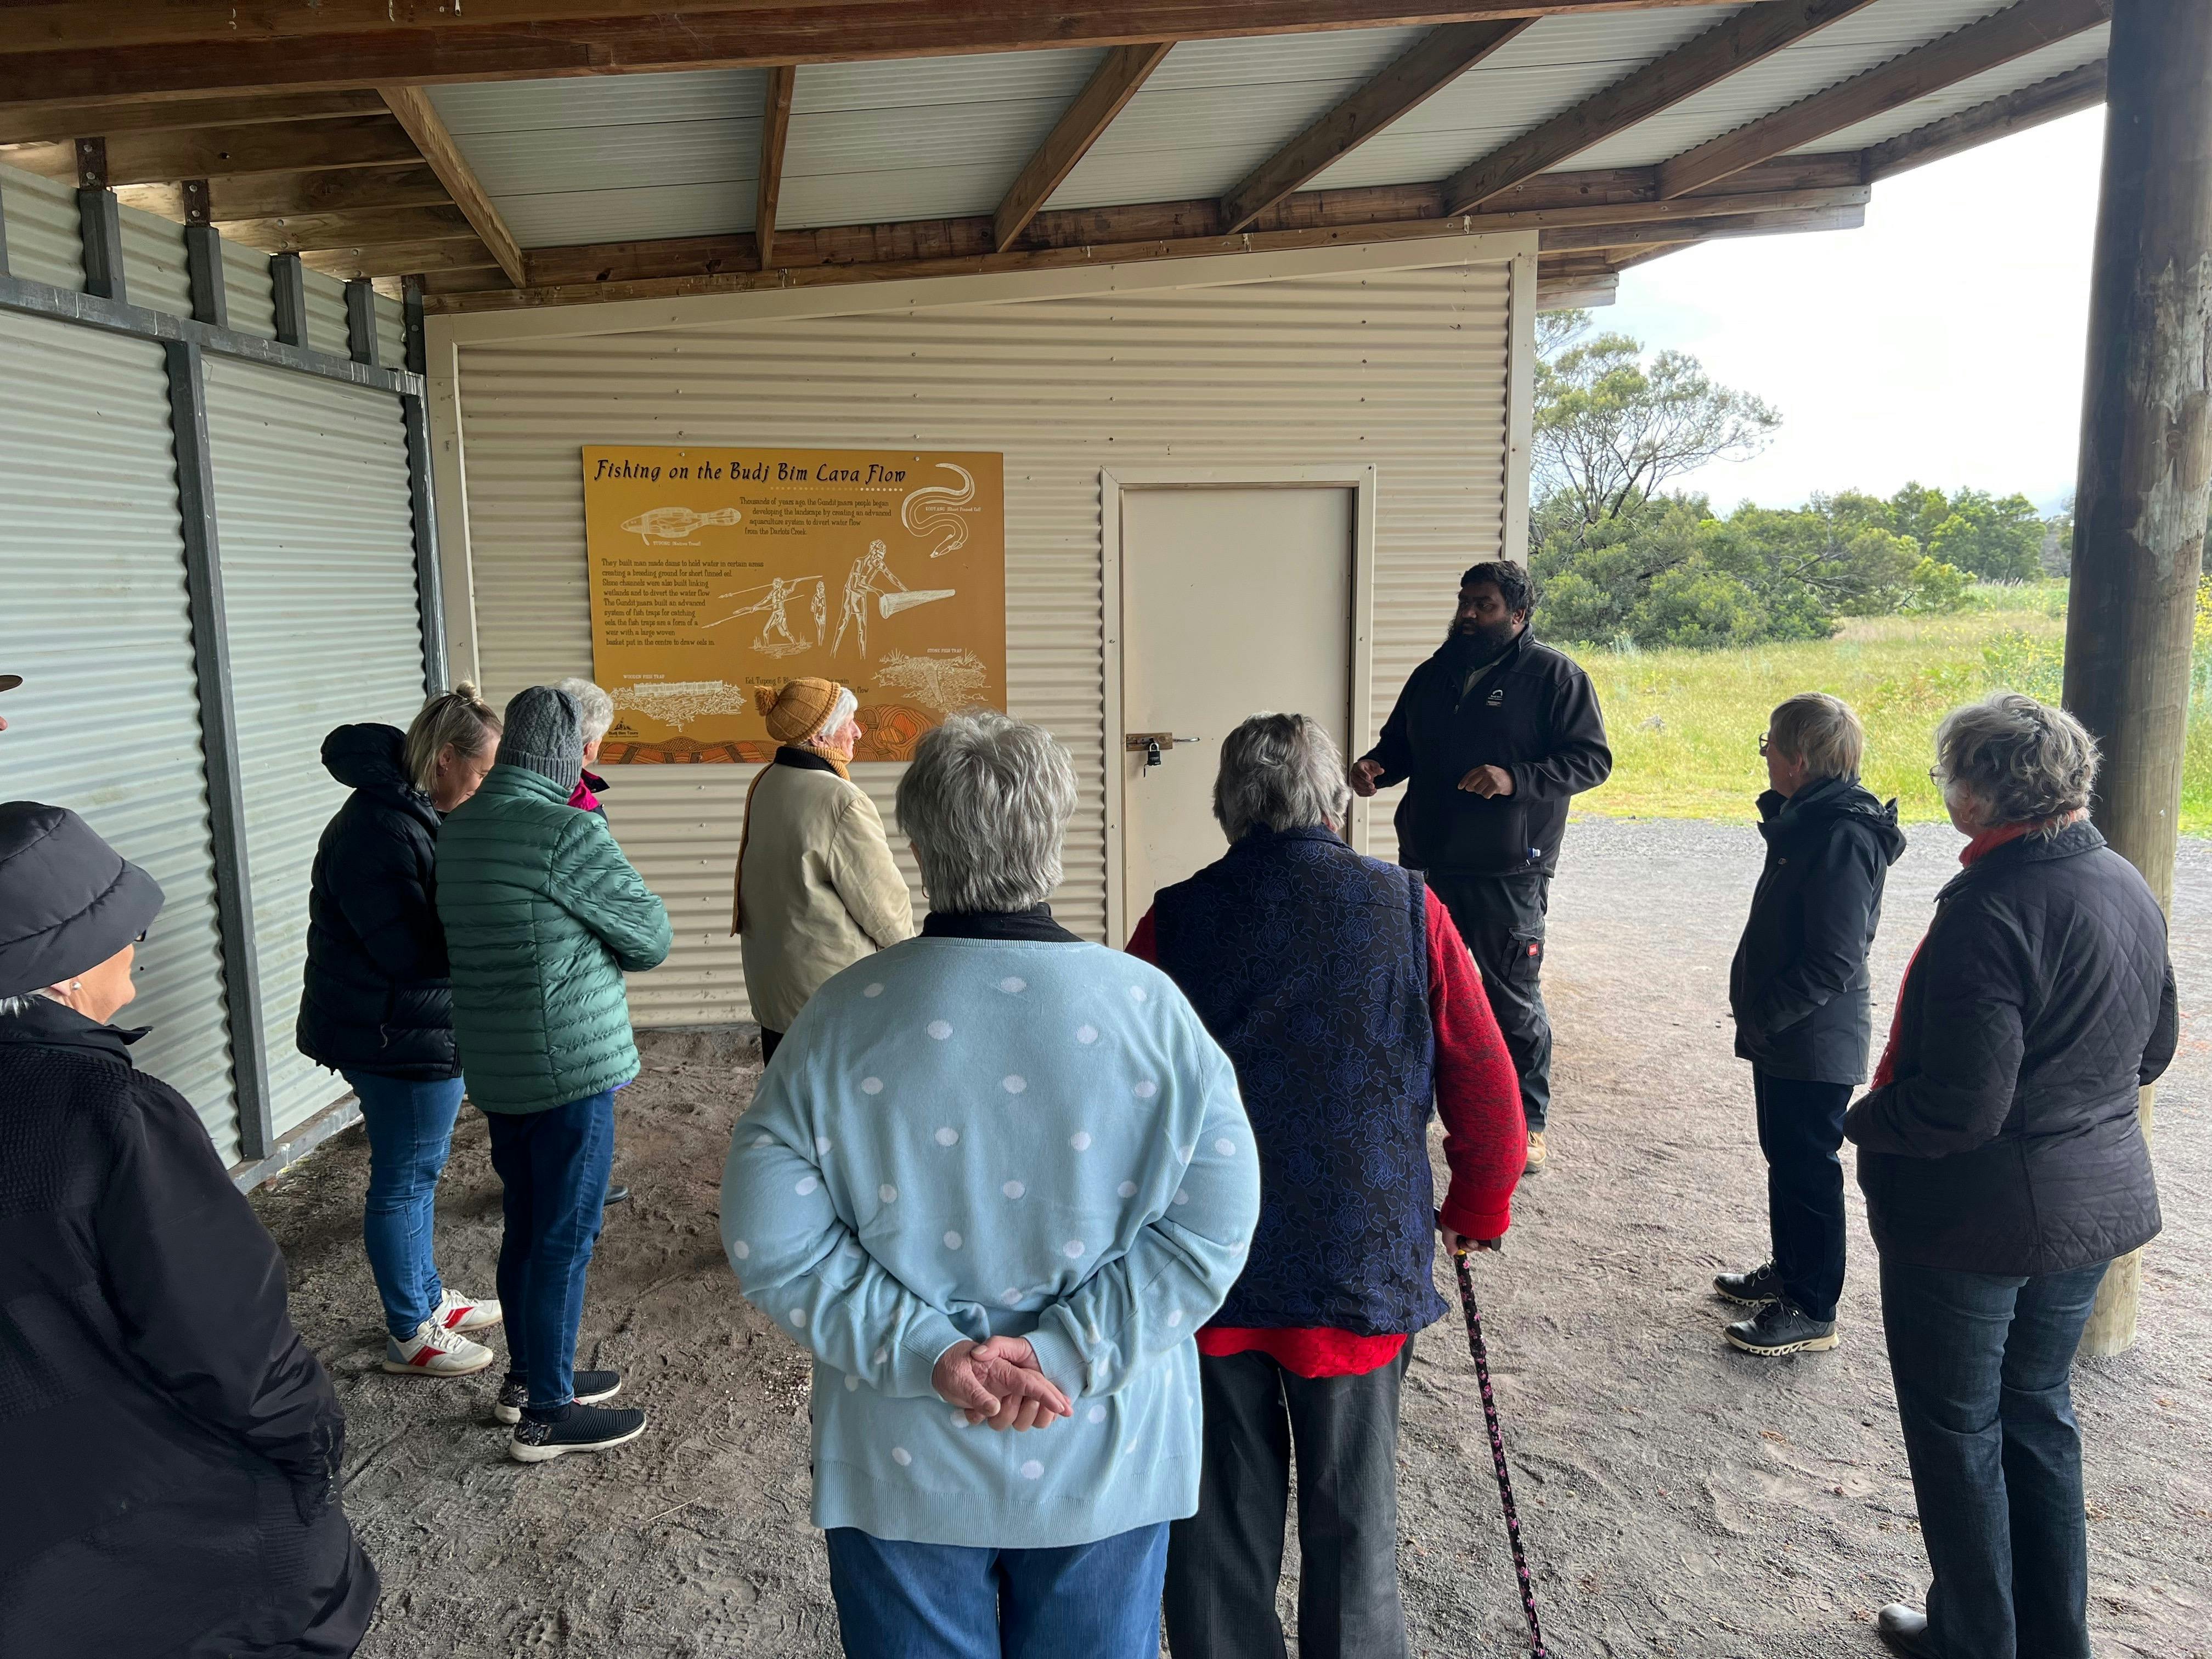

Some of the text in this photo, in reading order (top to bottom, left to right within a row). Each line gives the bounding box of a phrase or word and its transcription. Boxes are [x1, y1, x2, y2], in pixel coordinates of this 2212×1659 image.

[594, 459, 661, 481] Fishing
[669, 467, 689, 478] on
[698, 461, 721, 479] the
[730, 462, 769, 483] Budj
[778, 462, 807, 480] Bim
[865, 464, 906, 484] Flow
[740, 496, 770, 505] Thousands
[855, 499, 871, 508] people
[873, 499, 889, 509] began
[753, 507, 783, 517] developing
[794, 508, 821, 517] landscape
[823, 509, 831, 517] by
[832, 509, 855, 518] creating
[749, 518, 783, 526] aquaculture
[785, 518, 804, 527] system
[601, 558, 617, 567] They
[602, 570, 626, 578] creating
[633, 569, 657, 578] breeding
[658, 569, 678, 578] ground
[689, 579, 709, 588] linking
[604, 598, 615, 606] The
[605, 609, 624, 617] system
[646, 609, 660, 618] traps
[671, 609, 696, 618] catching
[641, 619, 655, 628] traps
[640, 629, 655, 637] large
[626, 639, 635, 647] put
[755, 677, 776, 686] Tupong
